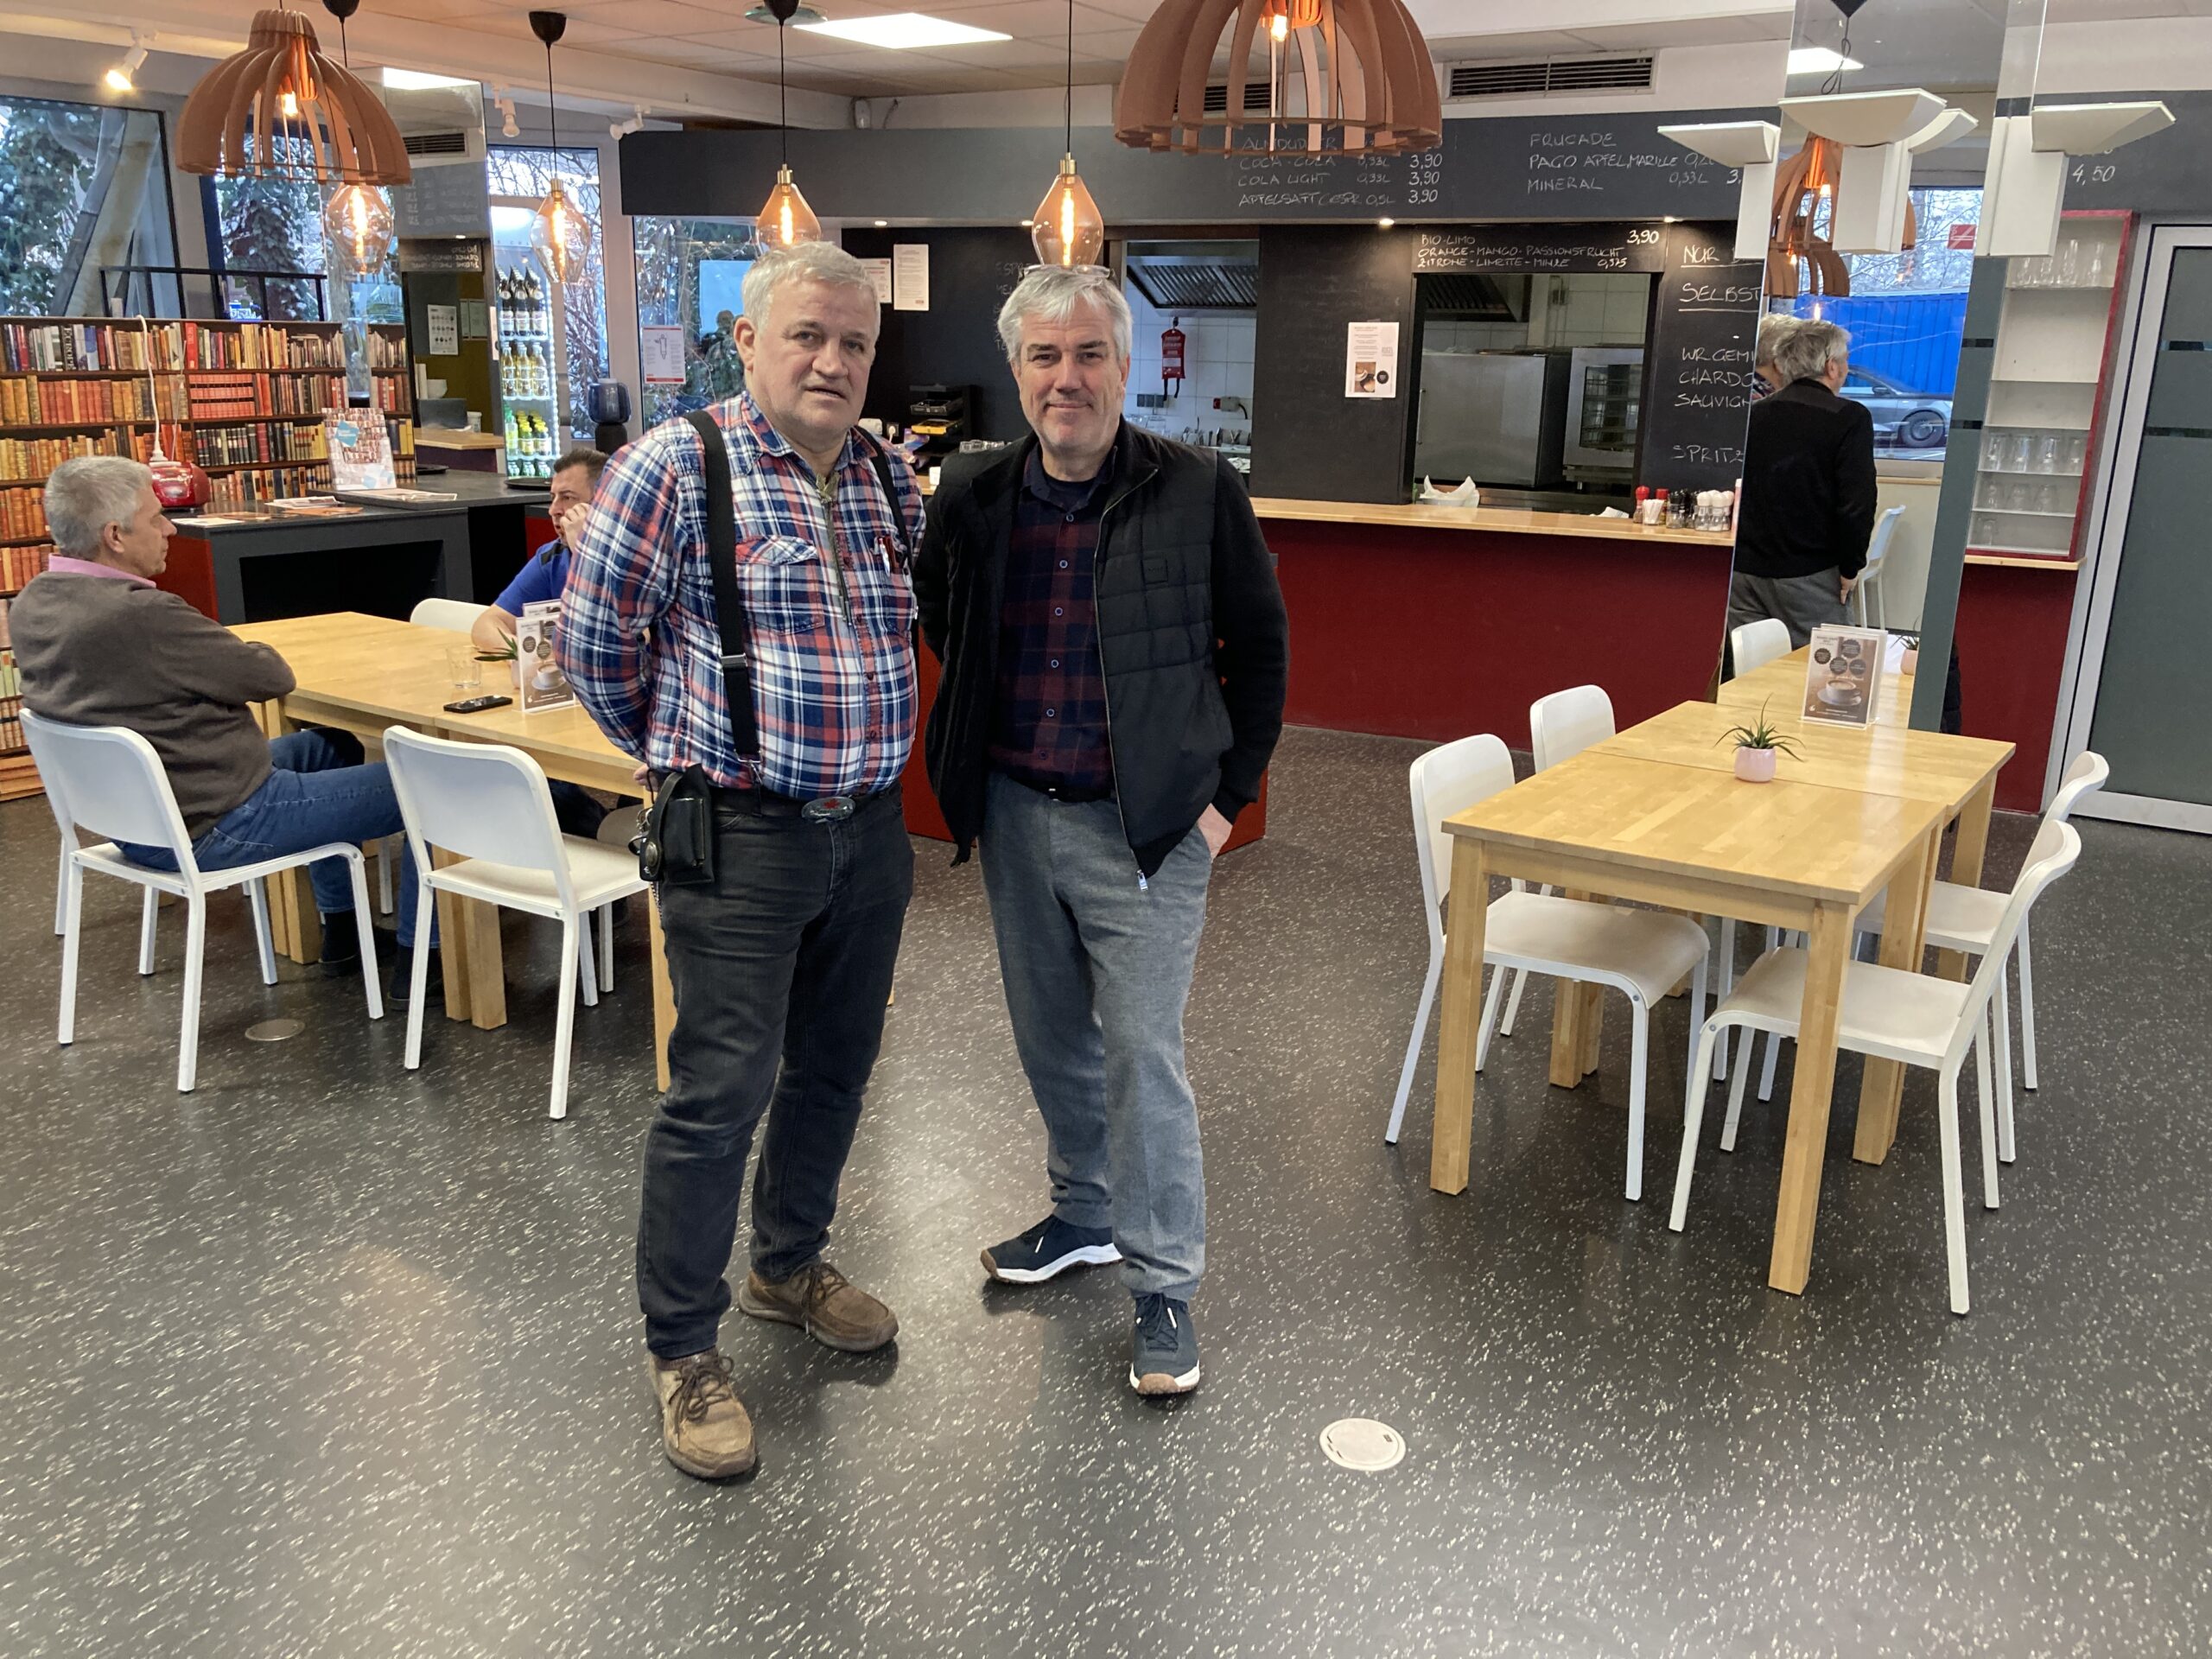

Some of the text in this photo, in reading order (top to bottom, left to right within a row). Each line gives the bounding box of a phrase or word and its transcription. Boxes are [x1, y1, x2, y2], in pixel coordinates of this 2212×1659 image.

[1529, 133, 1617, 147] FRUCADE
[1409, 153, 1443, 170] 3,90
[1529, 154, 1576, 168] PAGO
[1237, 171, 1441, 188] COLA LIGHT 0,33L 3,90
[1527, 177, 1604, 194] MINERAL
[1669, 171, 1709, 188] 0,33L
[2072, 164, 2116, 186] 4,50
[1408, 189, 1439, 204] 3,90
[1626, 229, 1660, 245] 3,90
[1683, 245, 1719, 264] NUR
